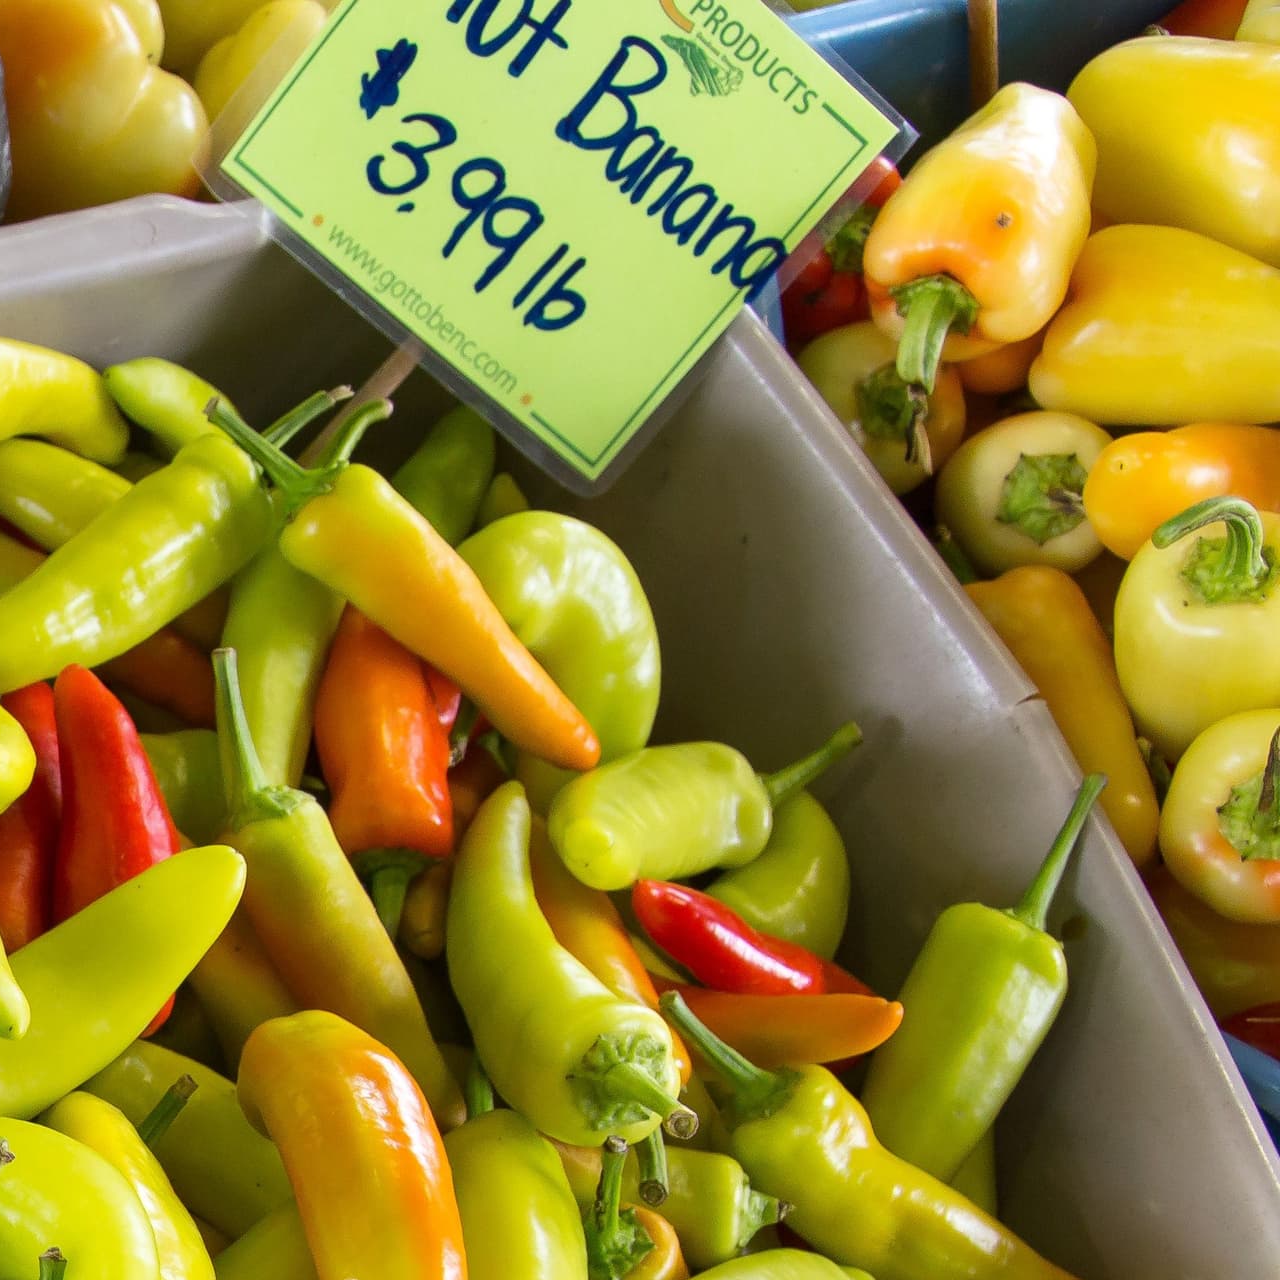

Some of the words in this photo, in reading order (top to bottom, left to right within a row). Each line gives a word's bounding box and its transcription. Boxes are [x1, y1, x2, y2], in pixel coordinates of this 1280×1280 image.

[689, 0, 819, 115] PRODUCTS
[446, 0, 572, 78] ot
[555, 35, 790, 303] Banana
[327, 224, 519, 394] www.gottobenc.com
